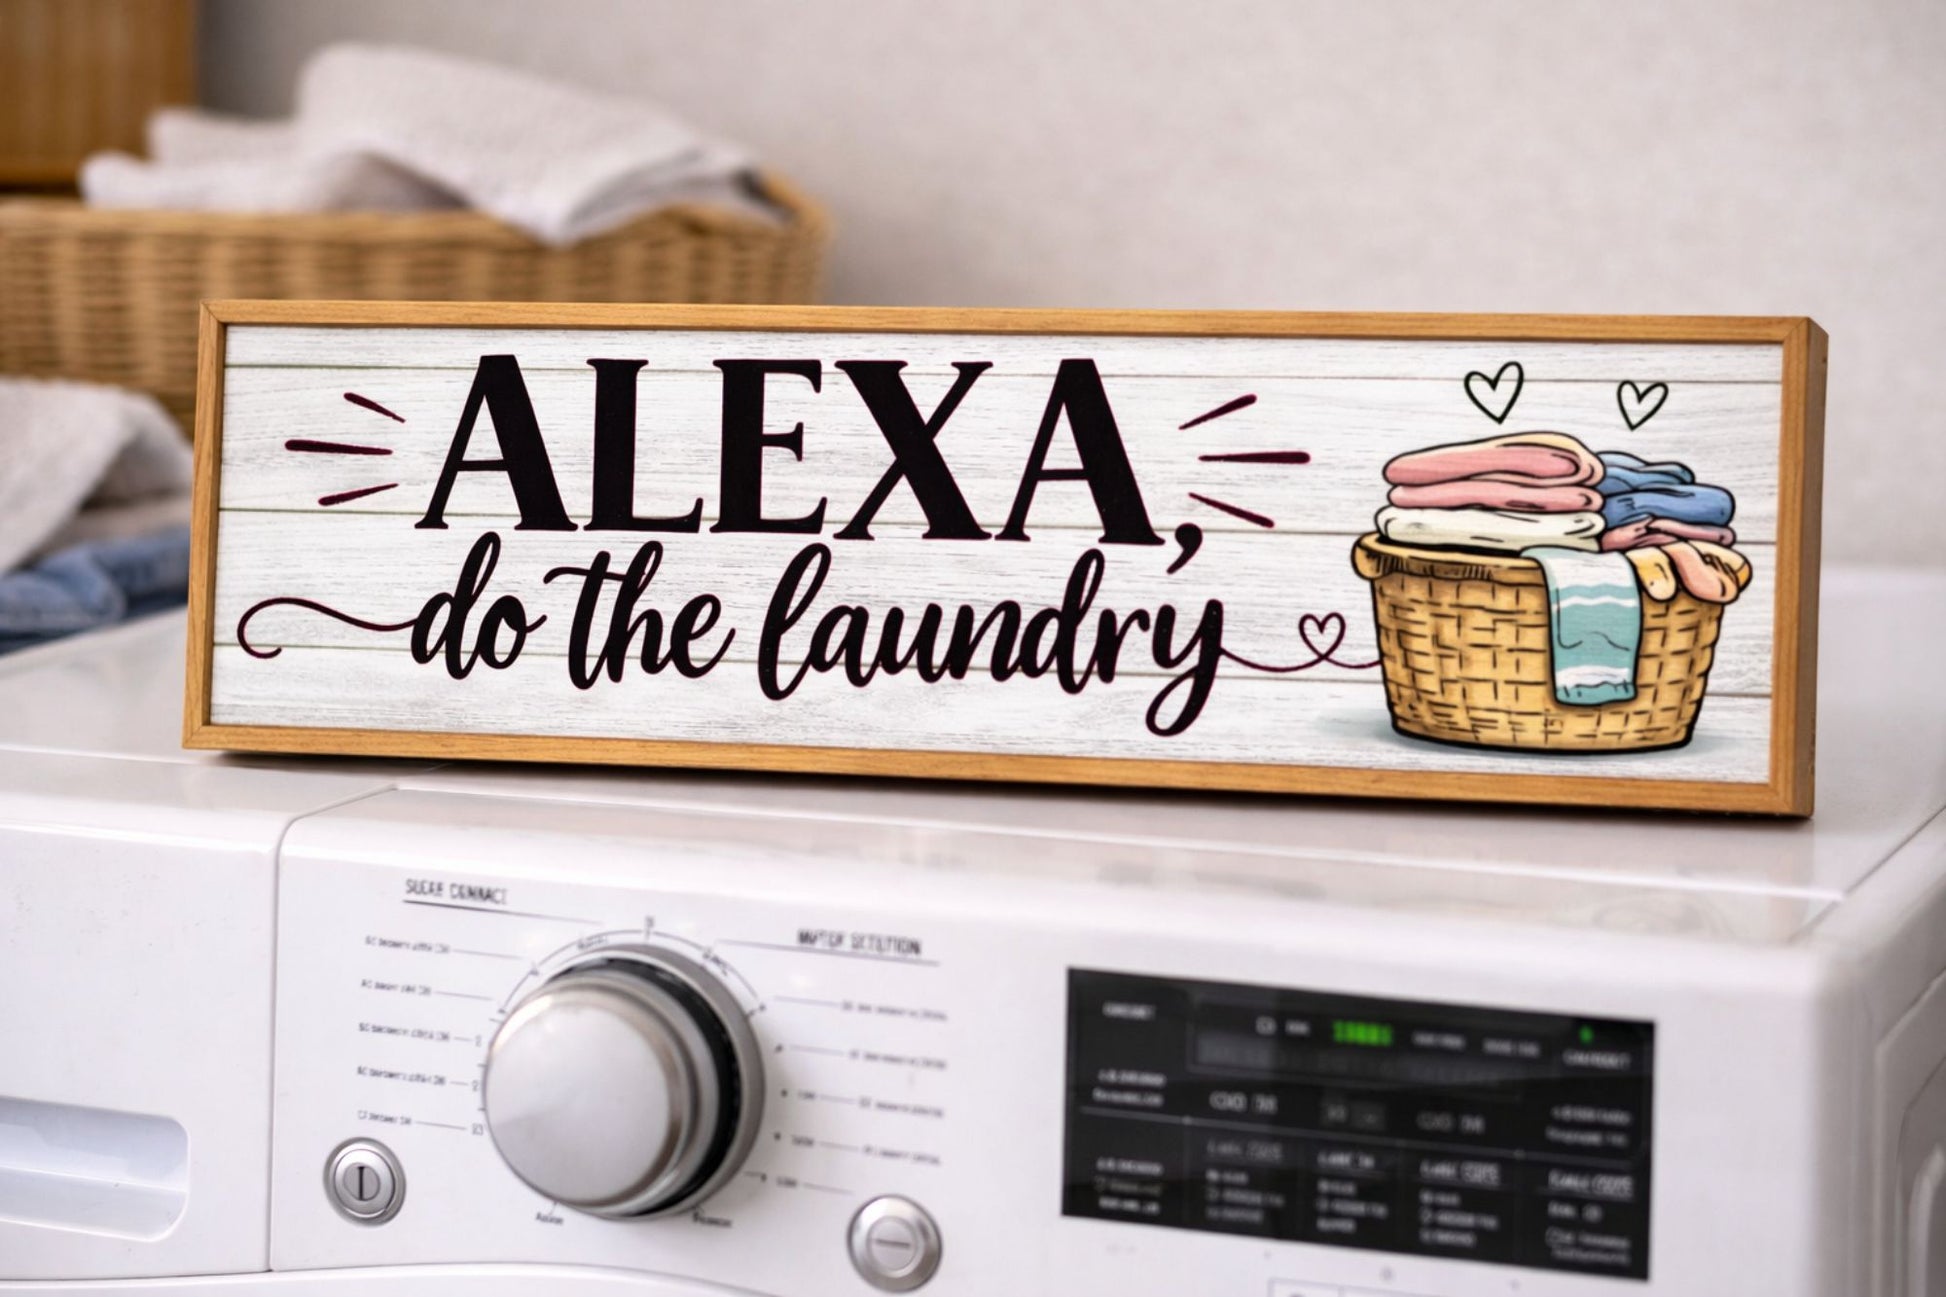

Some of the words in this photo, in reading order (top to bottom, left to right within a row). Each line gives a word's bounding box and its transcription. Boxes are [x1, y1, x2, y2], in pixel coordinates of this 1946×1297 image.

[414, 354, 1203, 575] ALEXA,
[411, 531, 547, 680] do
[543, 540, 736, 690] the
[757, 542, 1223, 737] laundry
